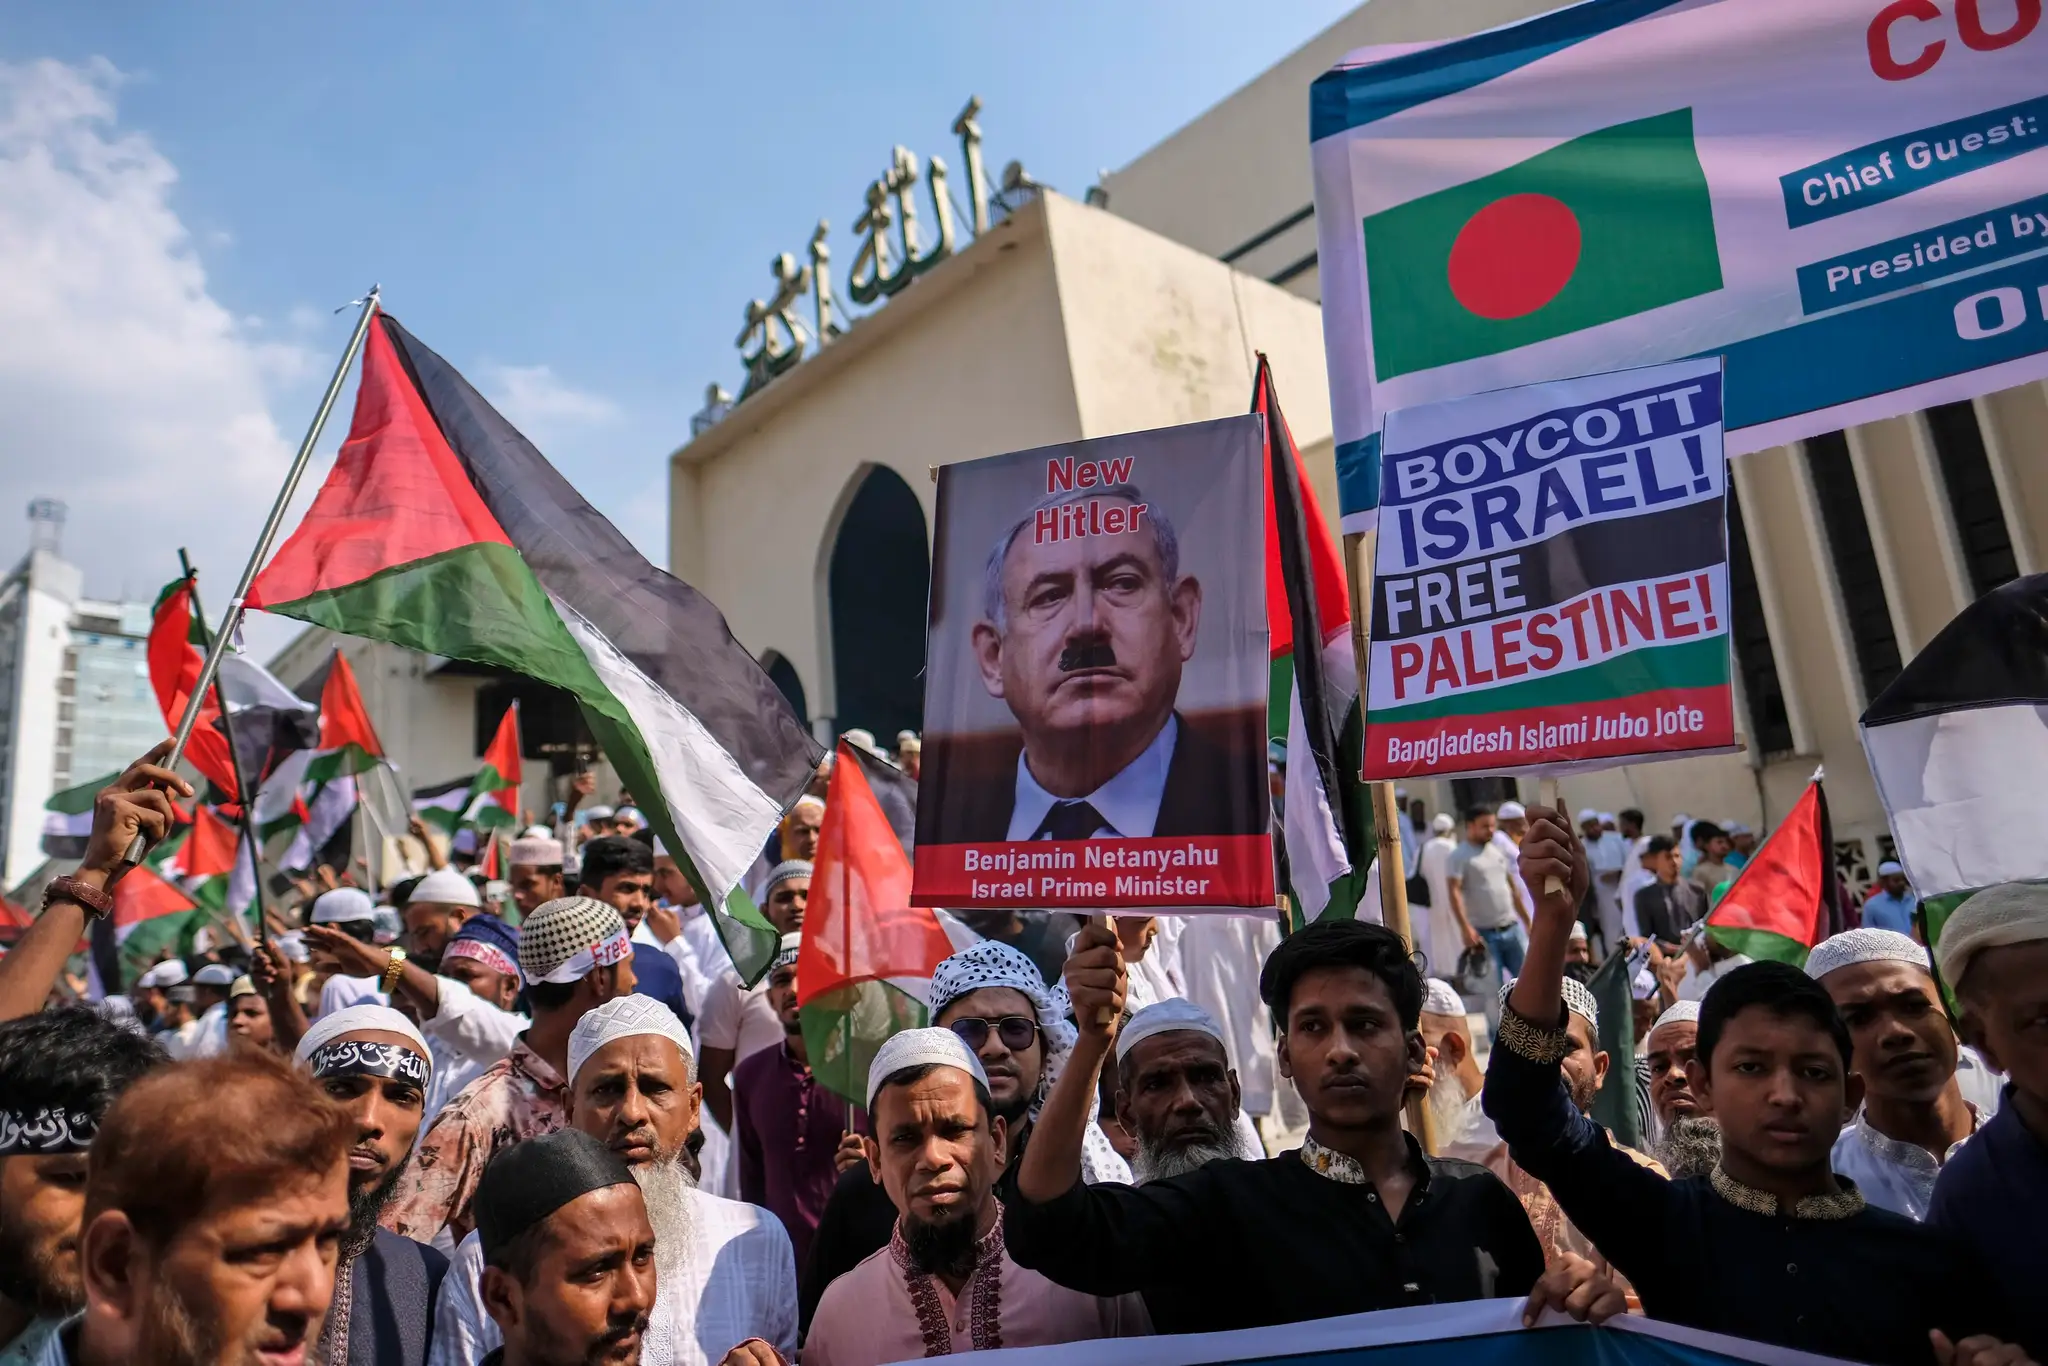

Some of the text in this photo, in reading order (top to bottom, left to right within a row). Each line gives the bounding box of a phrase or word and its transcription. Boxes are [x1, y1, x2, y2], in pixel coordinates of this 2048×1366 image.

[1802, 115, 2038, 206] Chief Guest:
[1827, 221, 1997, 293] Presided
[1046, 456, 1135, 493] New
[1396, 385, 1702, 499] BOYCOTT
[1033, 501, 1147, 544] Hitler
[1398, 434, 1712, 568] ISRAEL!
[1384, 554, 1527, 634] FREE
[1390, 573, 1718, 700] PALESTINE!
[1388, 704, 1703, 765] Bangladesh Islami Jubo Jote
[965, 844, 1218, 874] Benjamin Netanyahu
[972, 876, 1210, 899] Israel Prime Minister
[590, 936, 628, 963] Free
